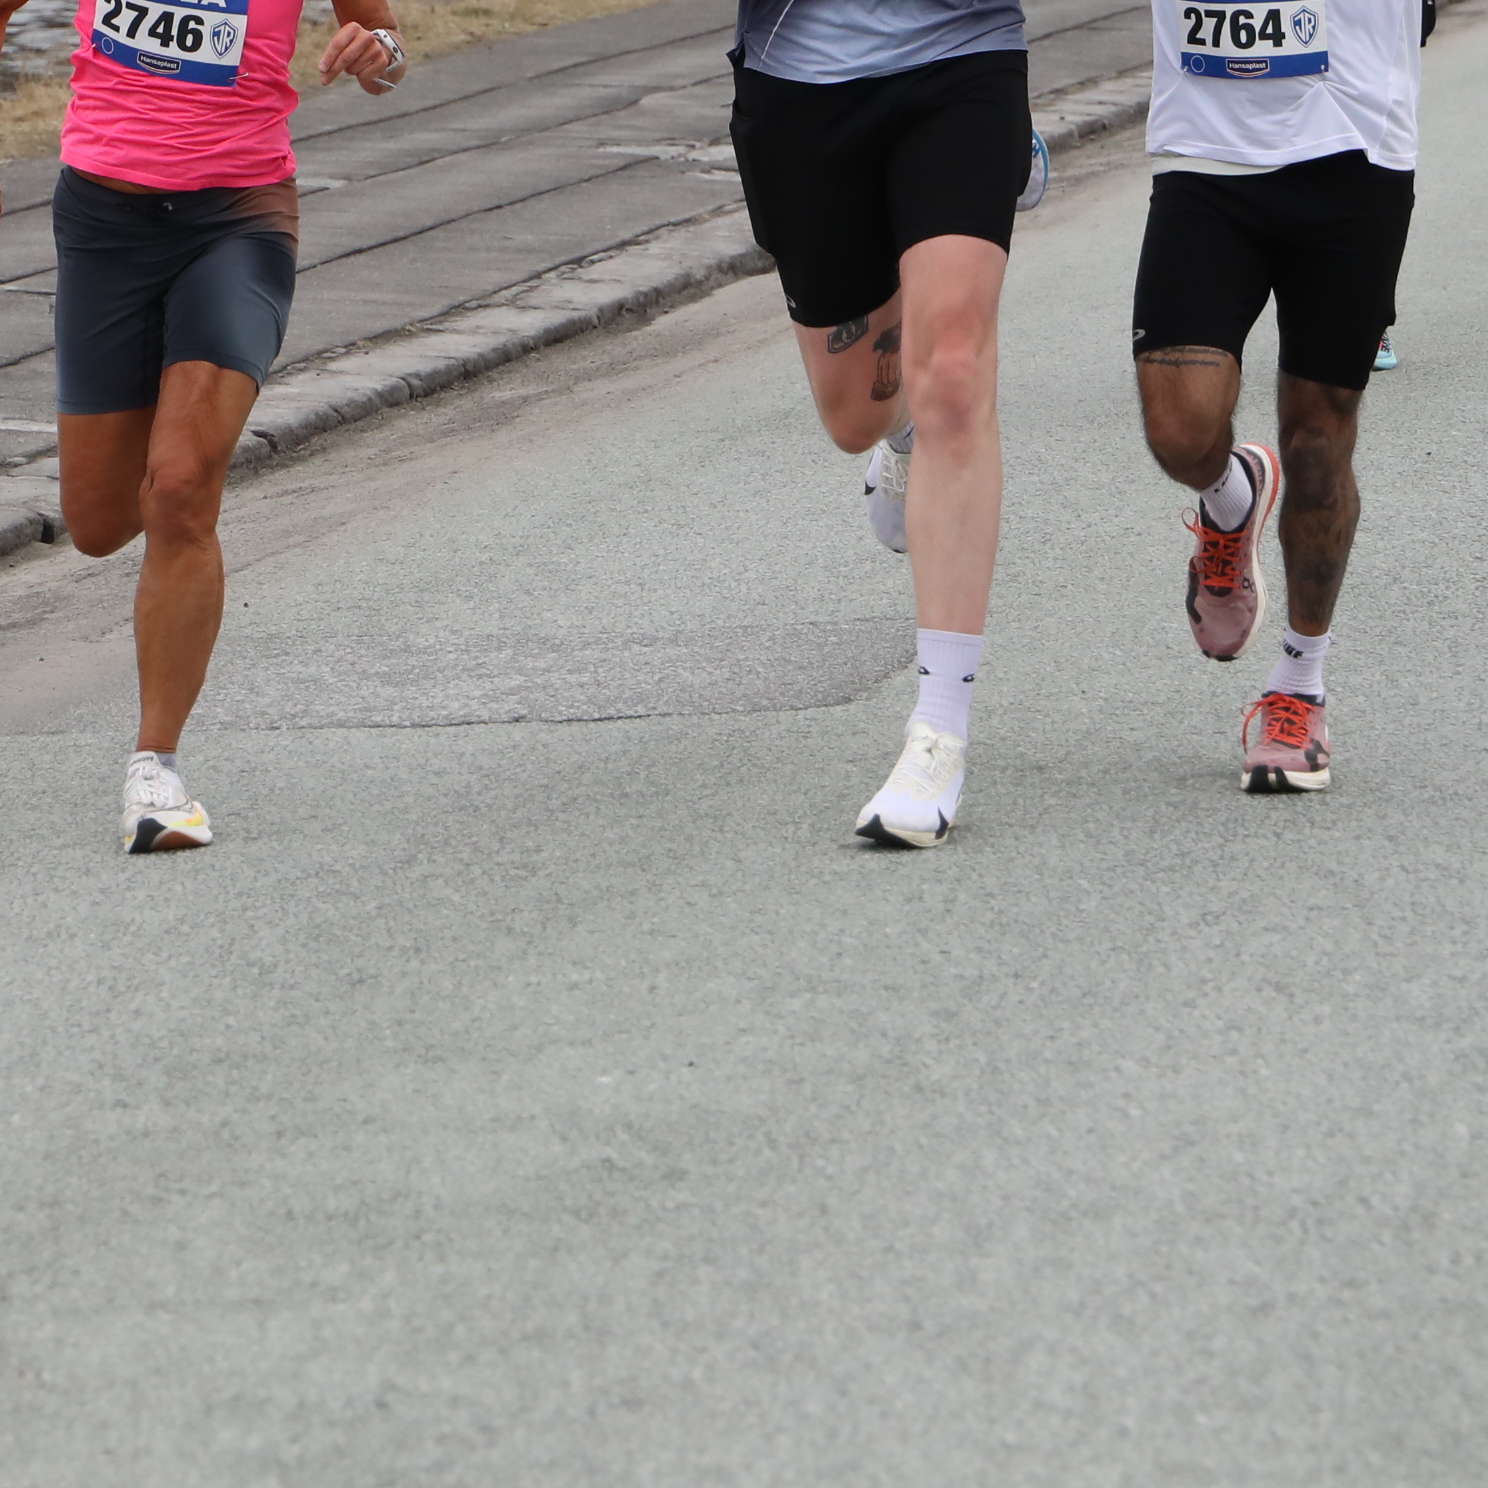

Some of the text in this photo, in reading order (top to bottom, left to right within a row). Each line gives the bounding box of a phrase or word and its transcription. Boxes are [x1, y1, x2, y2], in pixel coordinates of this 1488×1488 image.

[1183, 6, 1286, 49] 2764
[140, 54, 178, 71] Hansaplast
[1228, 61, 1267, 70] Hansaplast
